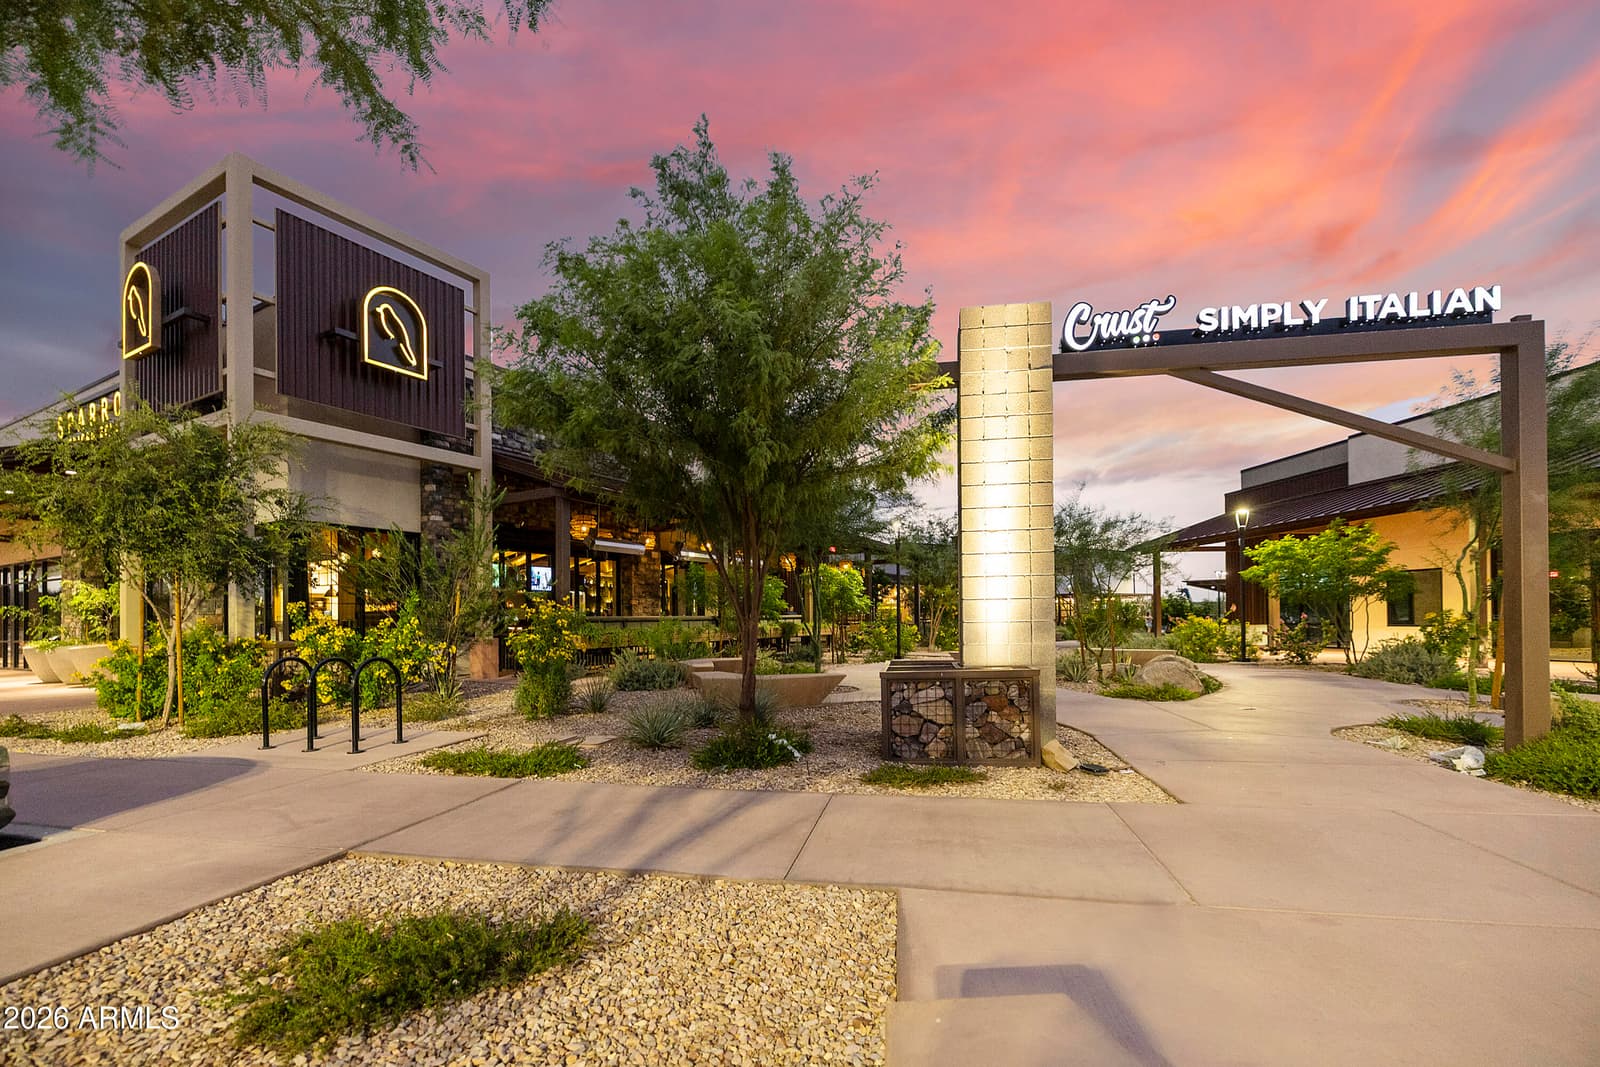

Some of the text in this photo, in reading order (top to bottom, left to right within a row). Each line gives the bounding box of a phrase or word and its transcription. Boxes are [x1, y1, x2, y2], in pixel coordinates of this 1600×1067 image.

[1063, 284, 1502, 351] Crust SIMPLY ITALIAN
